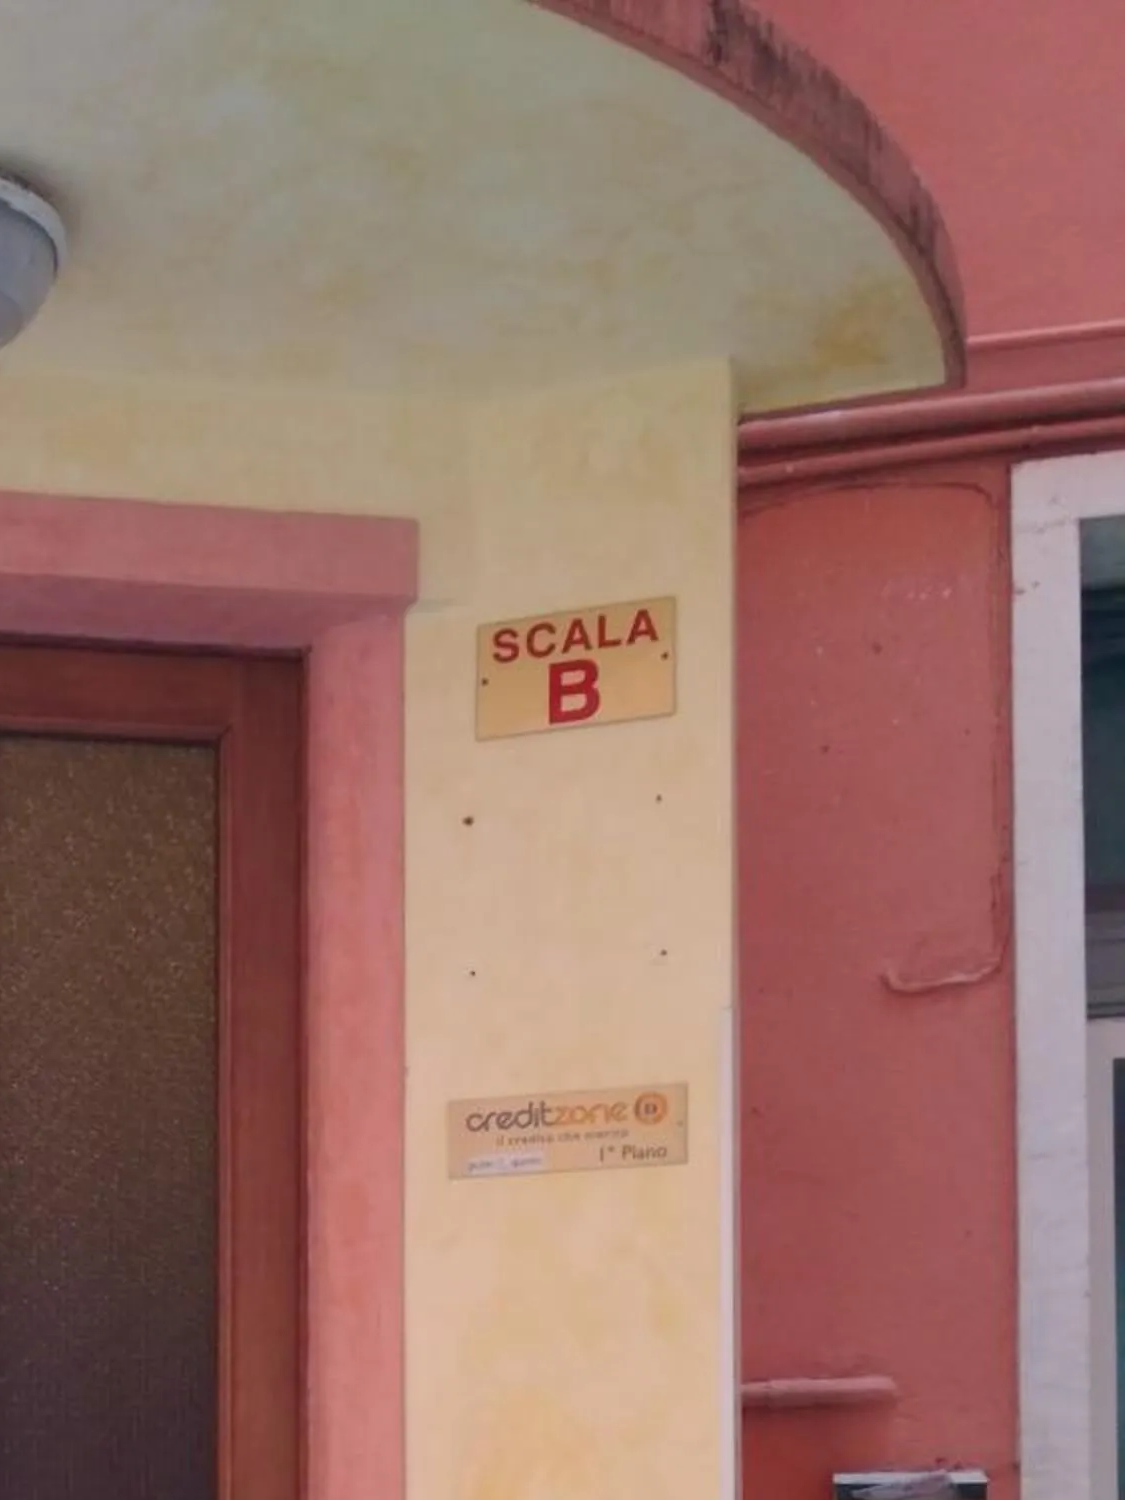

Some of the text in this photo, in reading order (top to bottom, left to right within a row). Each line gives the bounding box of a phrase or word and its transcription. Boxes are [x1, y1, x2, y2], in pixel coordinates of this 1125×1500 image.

[492, 609, 659, 663] SCALA
[548, 658, 601, 725] B
[466, 1101, 629, 1132] creditzone
[621, 1144, 668, 1161] Piano
